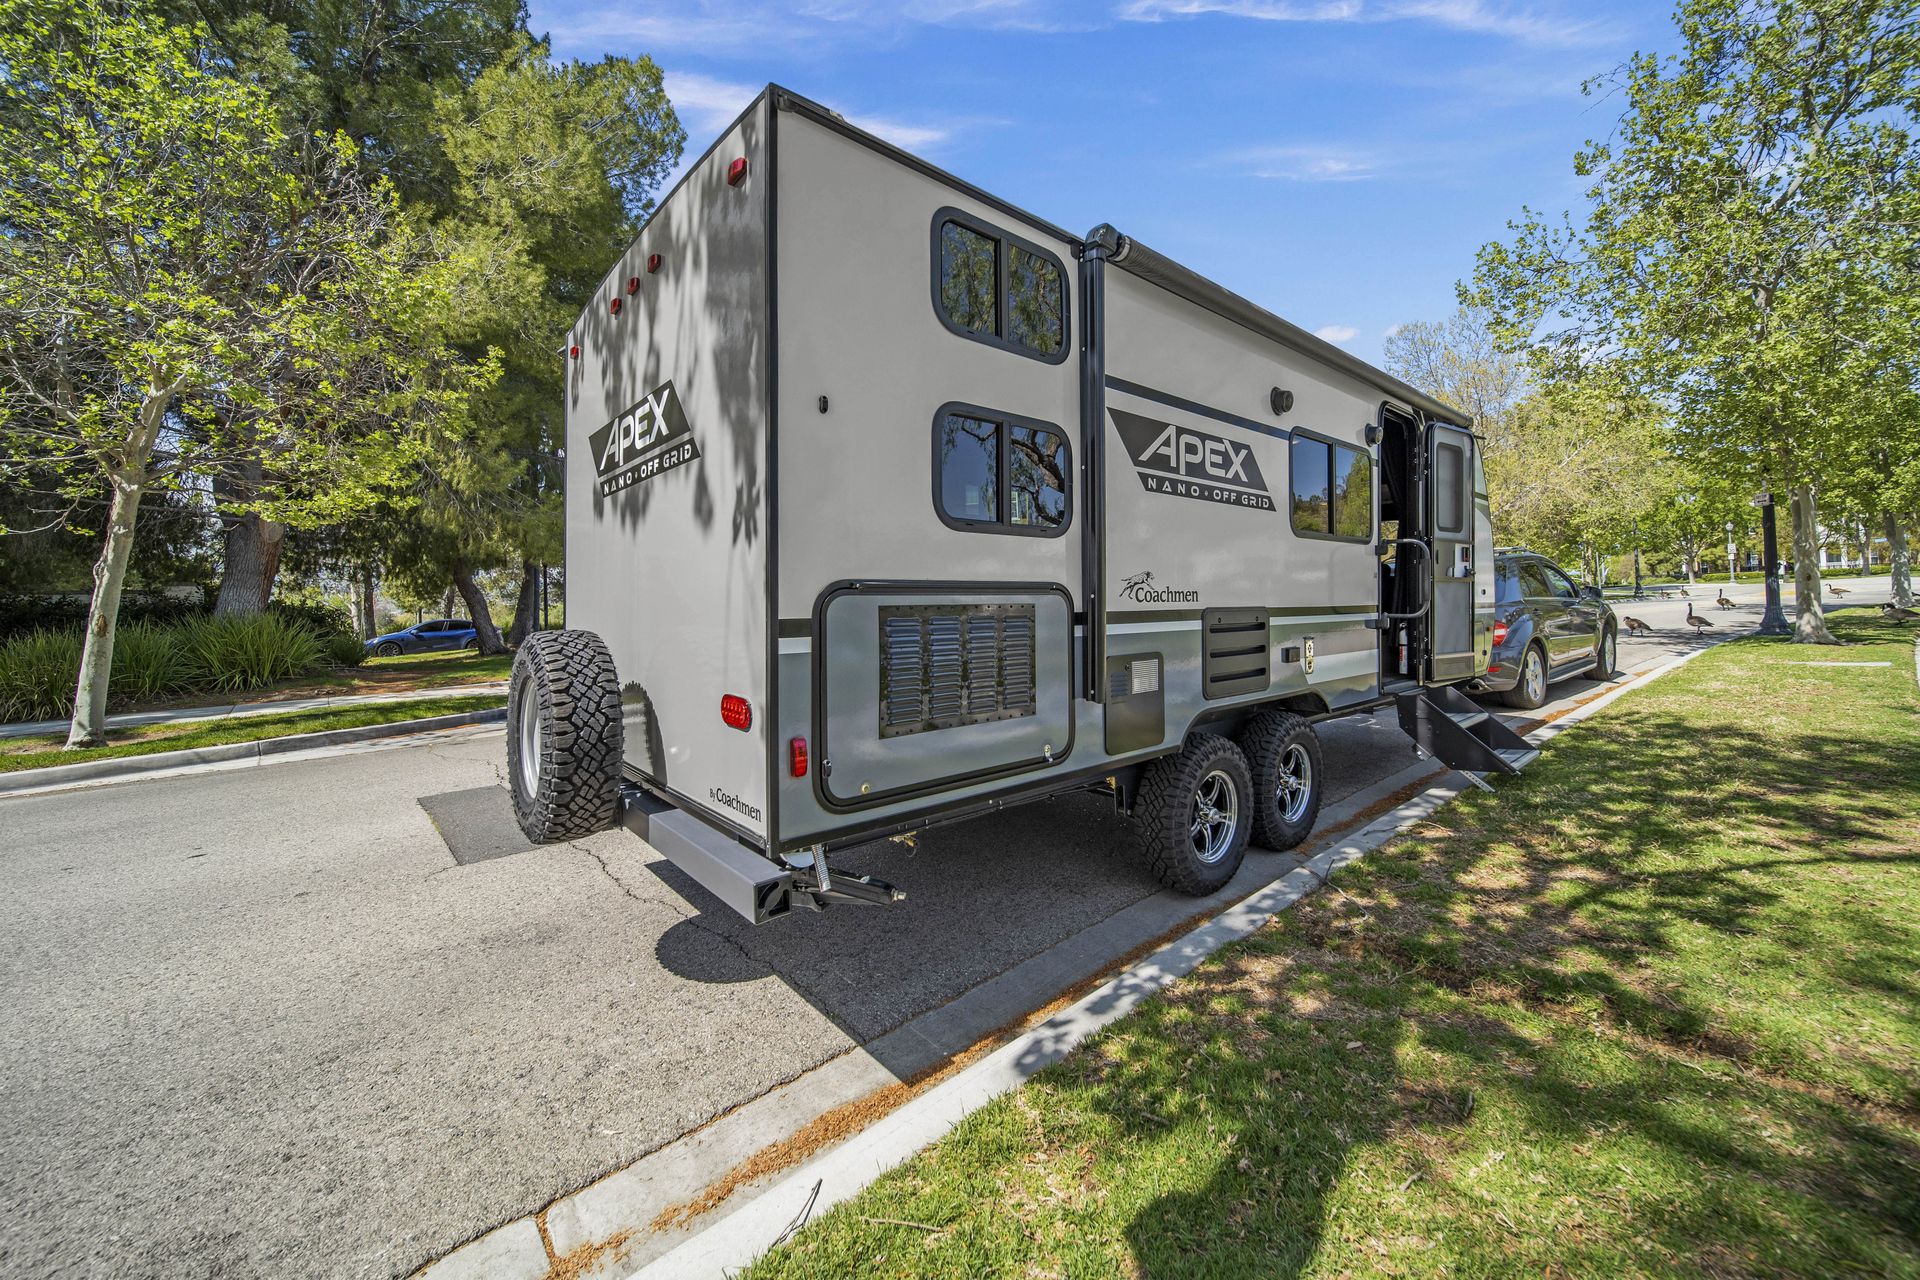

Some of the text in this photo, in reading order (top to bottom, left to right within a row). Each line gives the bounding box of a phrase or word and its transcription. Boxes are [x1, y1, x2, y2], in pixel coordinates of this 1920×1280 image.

[600, 388, 670, 471] APEX
[603, 444, 692, 496] NANO OFF GRID
[1138, 424, 1249, 482] APEX
[1148, 477, 1270, 508] NANO OFF GRID
[1134, 586, 1199, 603] Coachmen
[716, 787, 762, 823] Coachmen
